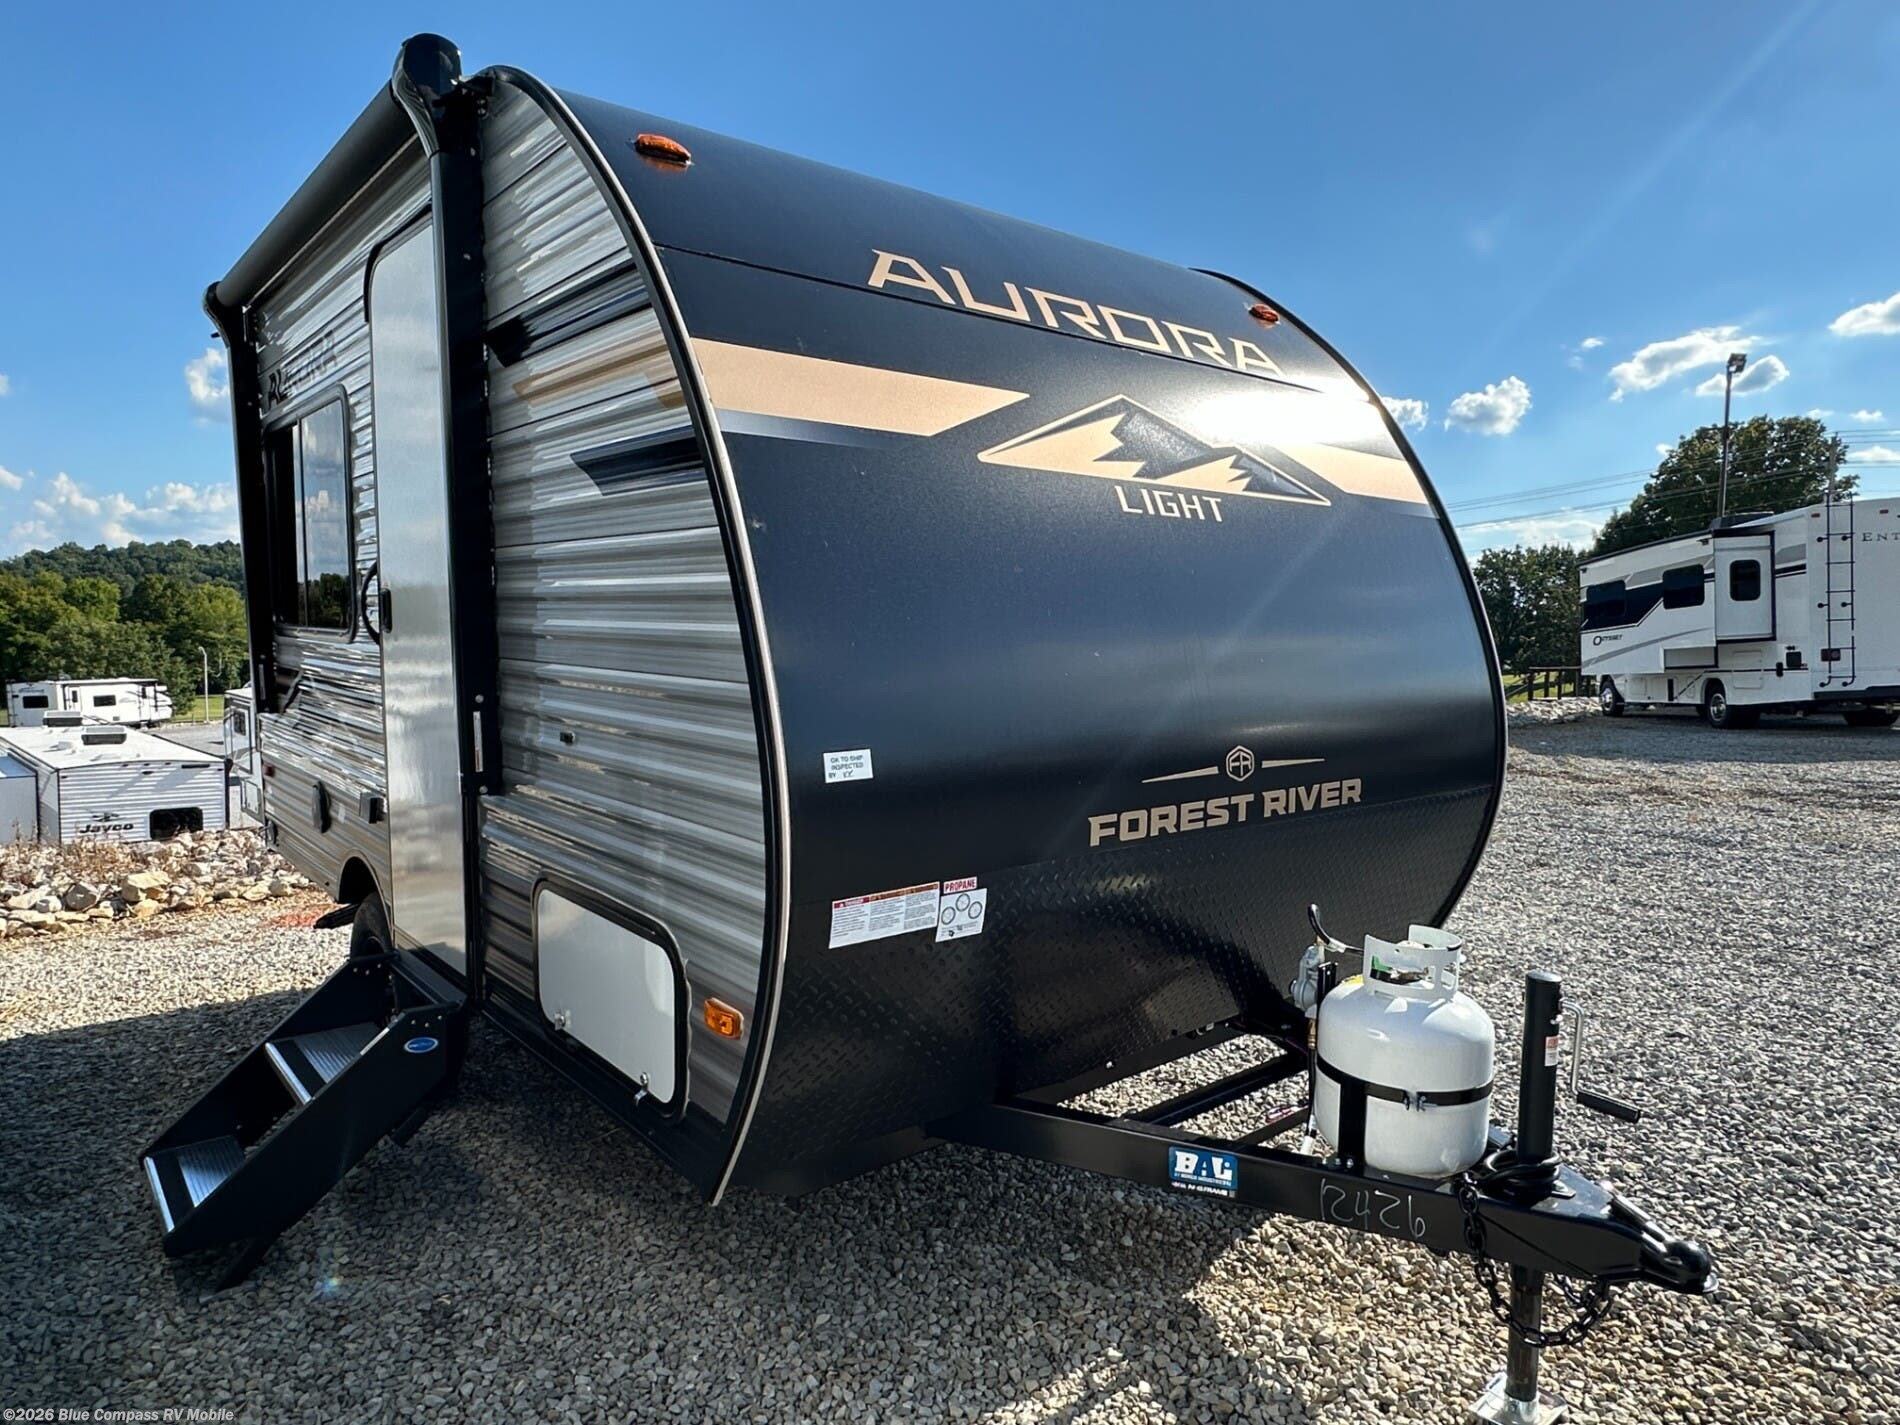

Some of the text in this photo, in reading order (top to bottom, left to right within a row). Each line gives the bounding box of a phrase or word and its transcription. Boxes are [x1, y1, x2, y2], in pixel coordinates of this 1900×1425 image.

[867, 248, 1284, 376] AURORA
[1115, 485, 1222, 522] LIGHT
[831, 762, 864, 771] INSPECTED
[1088, 778, 1362, 847] FOREST RIVER
[79, 823, 135, 834] Jayco
[944, 879, 976, 892] PROPANE
[1174, 1151, 1233, 1181] BAL
